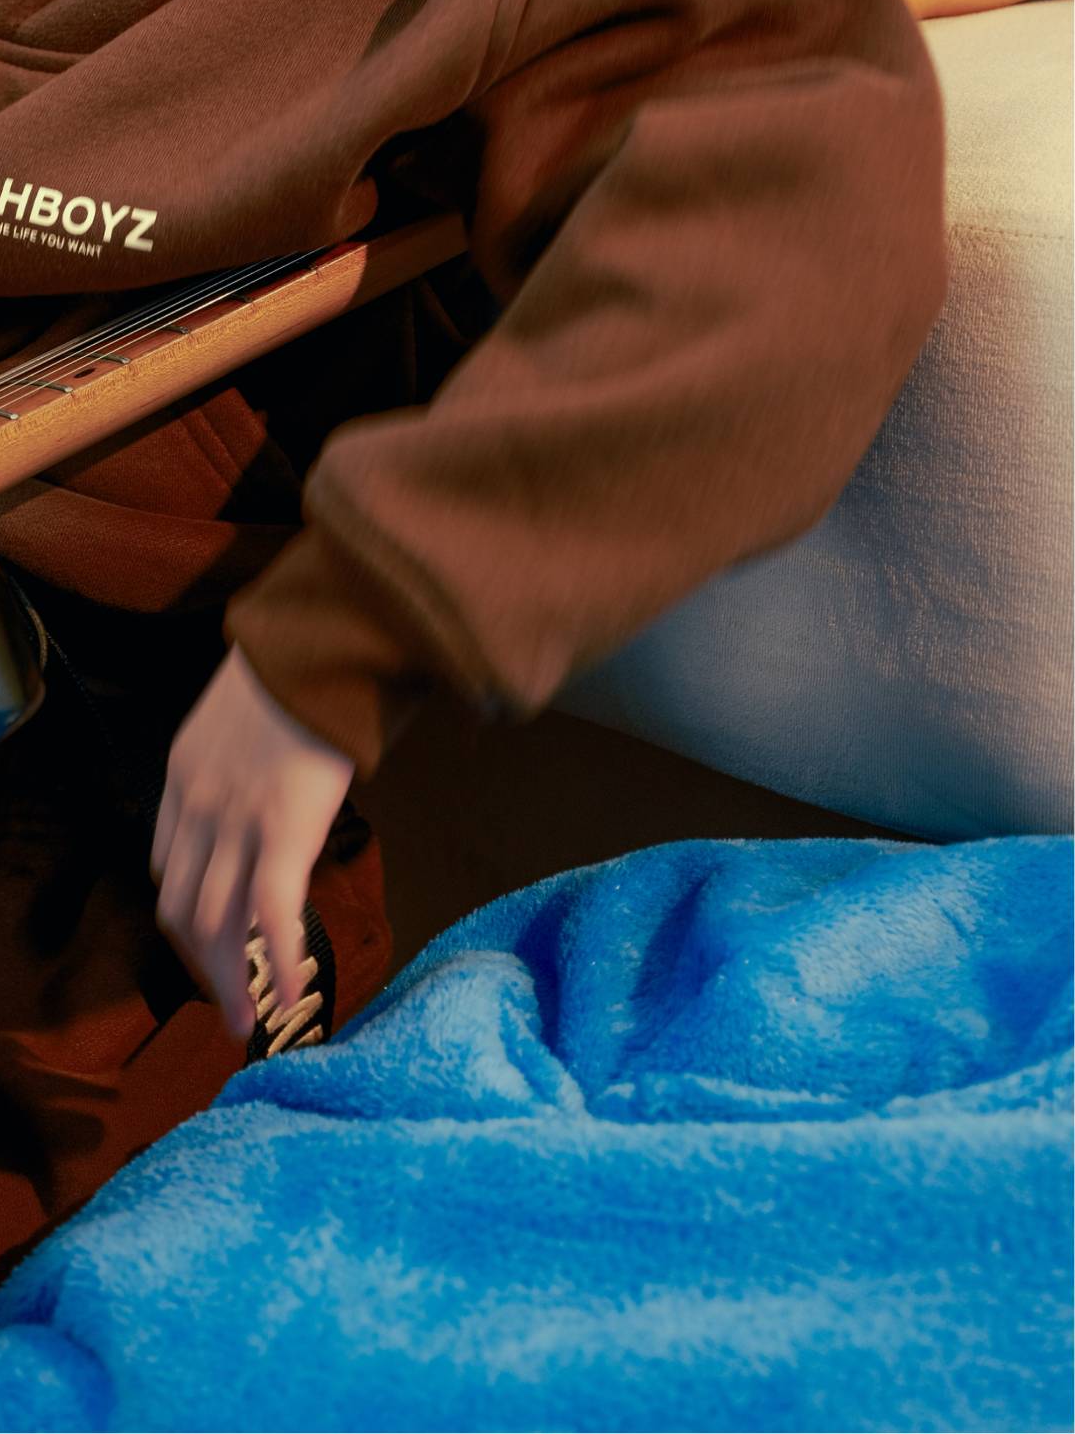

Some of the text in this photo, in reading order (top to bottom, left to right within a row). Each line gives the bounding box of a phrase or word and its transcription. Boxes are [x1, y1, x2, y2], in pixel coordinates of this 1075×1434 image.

[13, 225, 39, 243] LIFE
[40, 231, 66, 250] YOU
[67, 238, 103, 258] WANT
